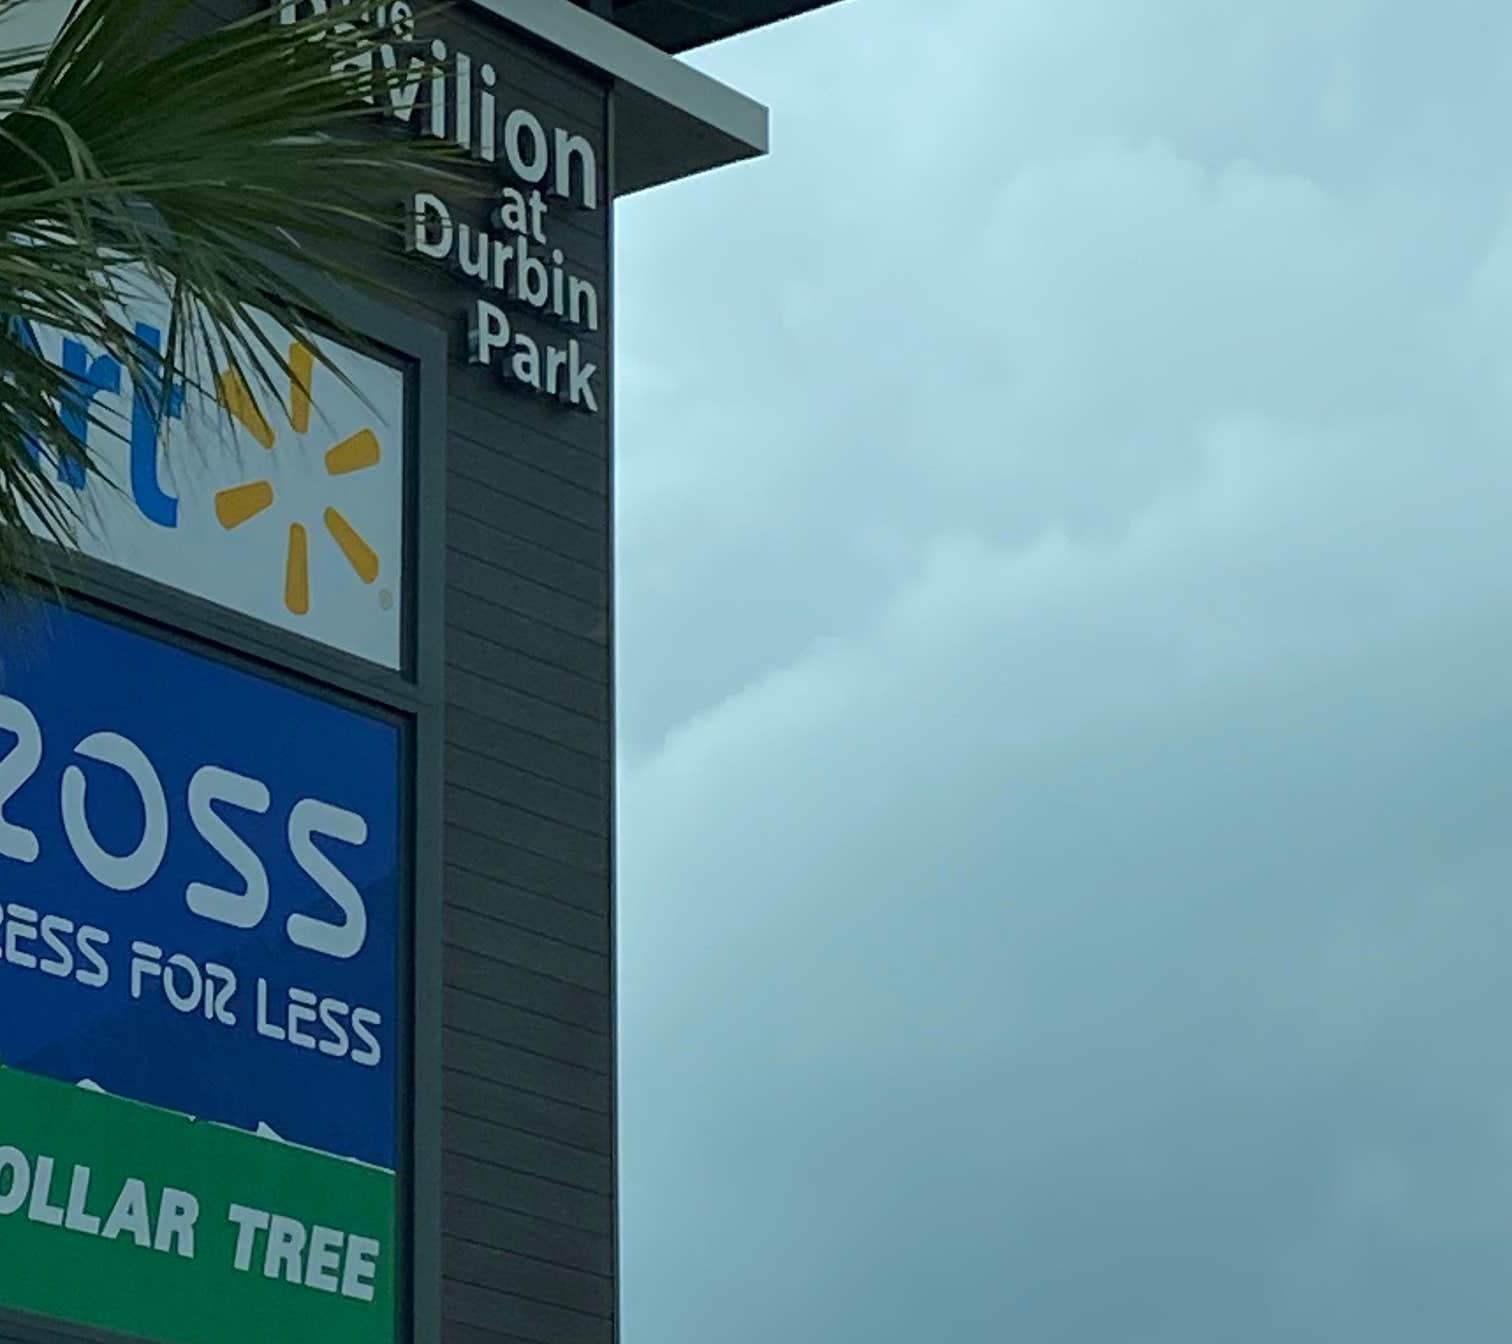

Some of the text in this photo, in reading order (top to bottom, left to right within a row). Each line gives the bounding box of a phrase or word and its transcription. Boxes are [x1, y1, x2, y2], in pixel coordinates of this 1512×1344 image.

[414, 193, 598, 330] Durbin
[500, 187, 548, 245] at
[477, 299, 598, 412] Park
[130, 940, 236, 1026] FOR
[256, 977, 382, 1067] LESS
[227, 1203, 380, 1302] TREE
